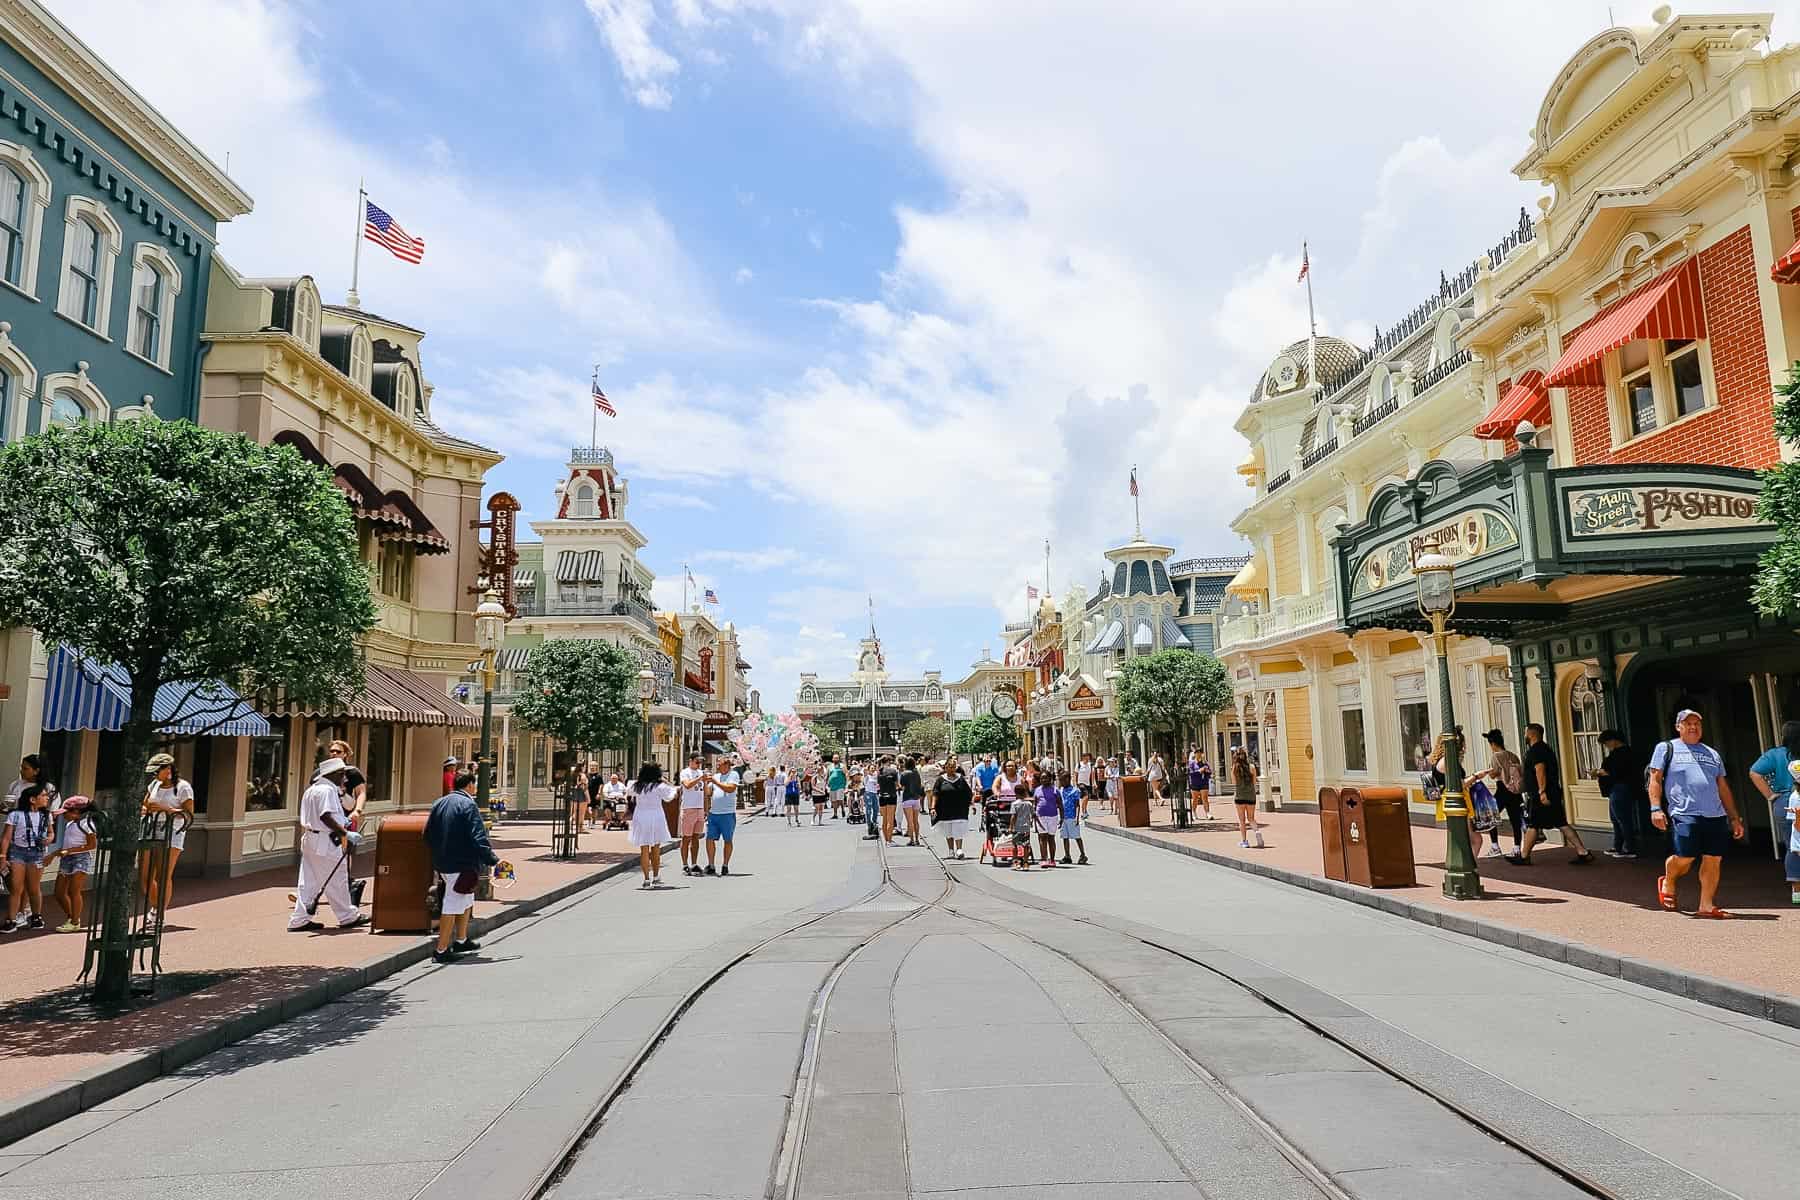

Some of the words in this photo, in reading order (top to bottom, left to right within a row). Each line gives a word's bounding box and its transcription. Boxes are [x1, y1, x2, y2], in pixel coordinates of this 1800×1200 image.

[1587, 503, 1628, 528] Street
[1598, 490, 1631, 508] Main
[1635, 487, 1762, 530] FASHIO
[495, 510, 507, 565] CRYSTAL
